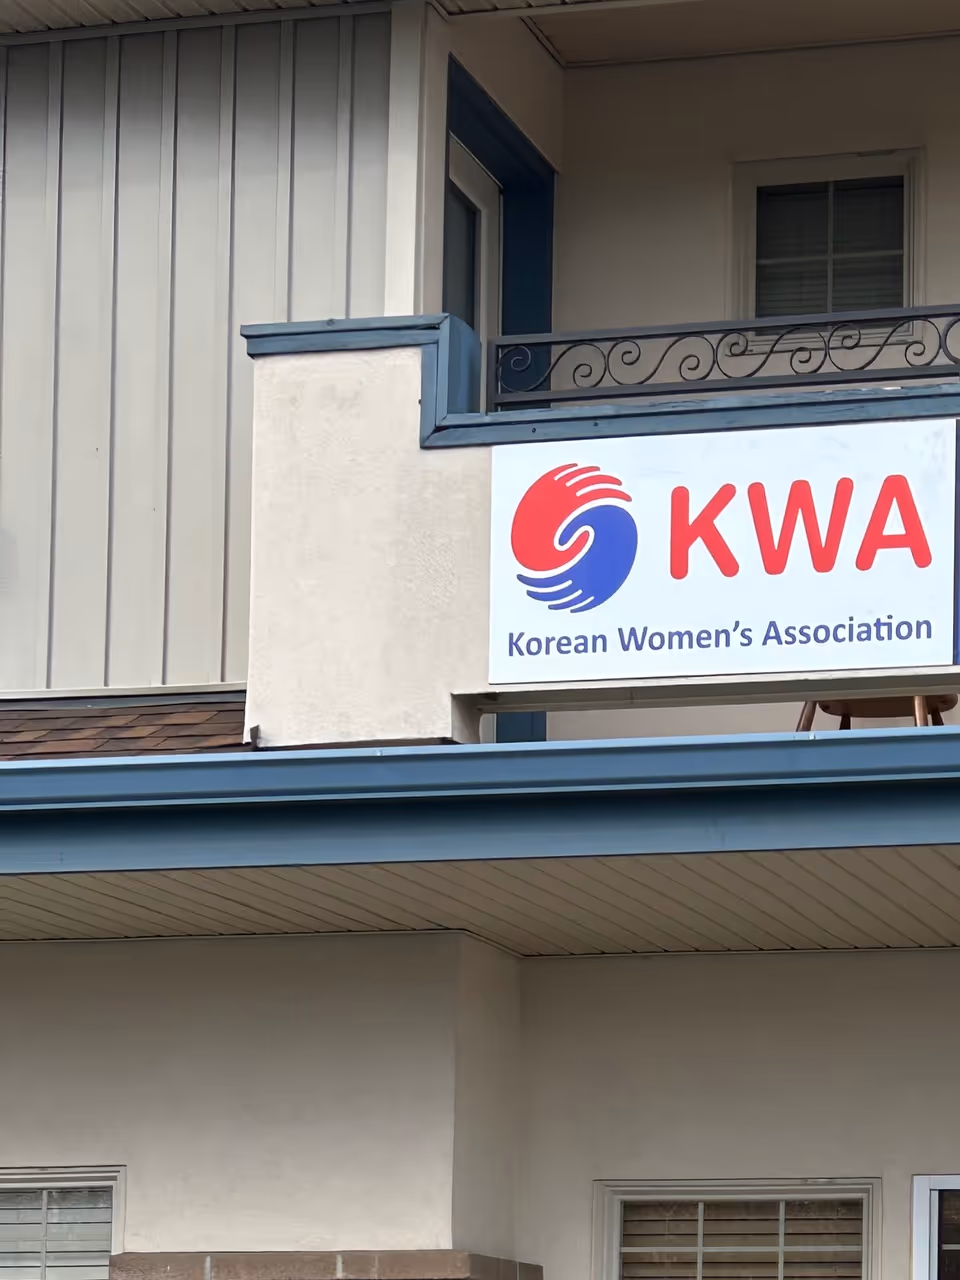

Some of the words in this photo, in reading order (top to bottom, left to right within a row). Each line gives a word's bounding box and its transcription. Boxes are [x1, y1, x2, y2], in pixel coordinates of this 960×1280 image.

[669, 474, 933, 580] KWA
[508, 631, 608, 657] Korean
[761, 615, 933, 646] Association
